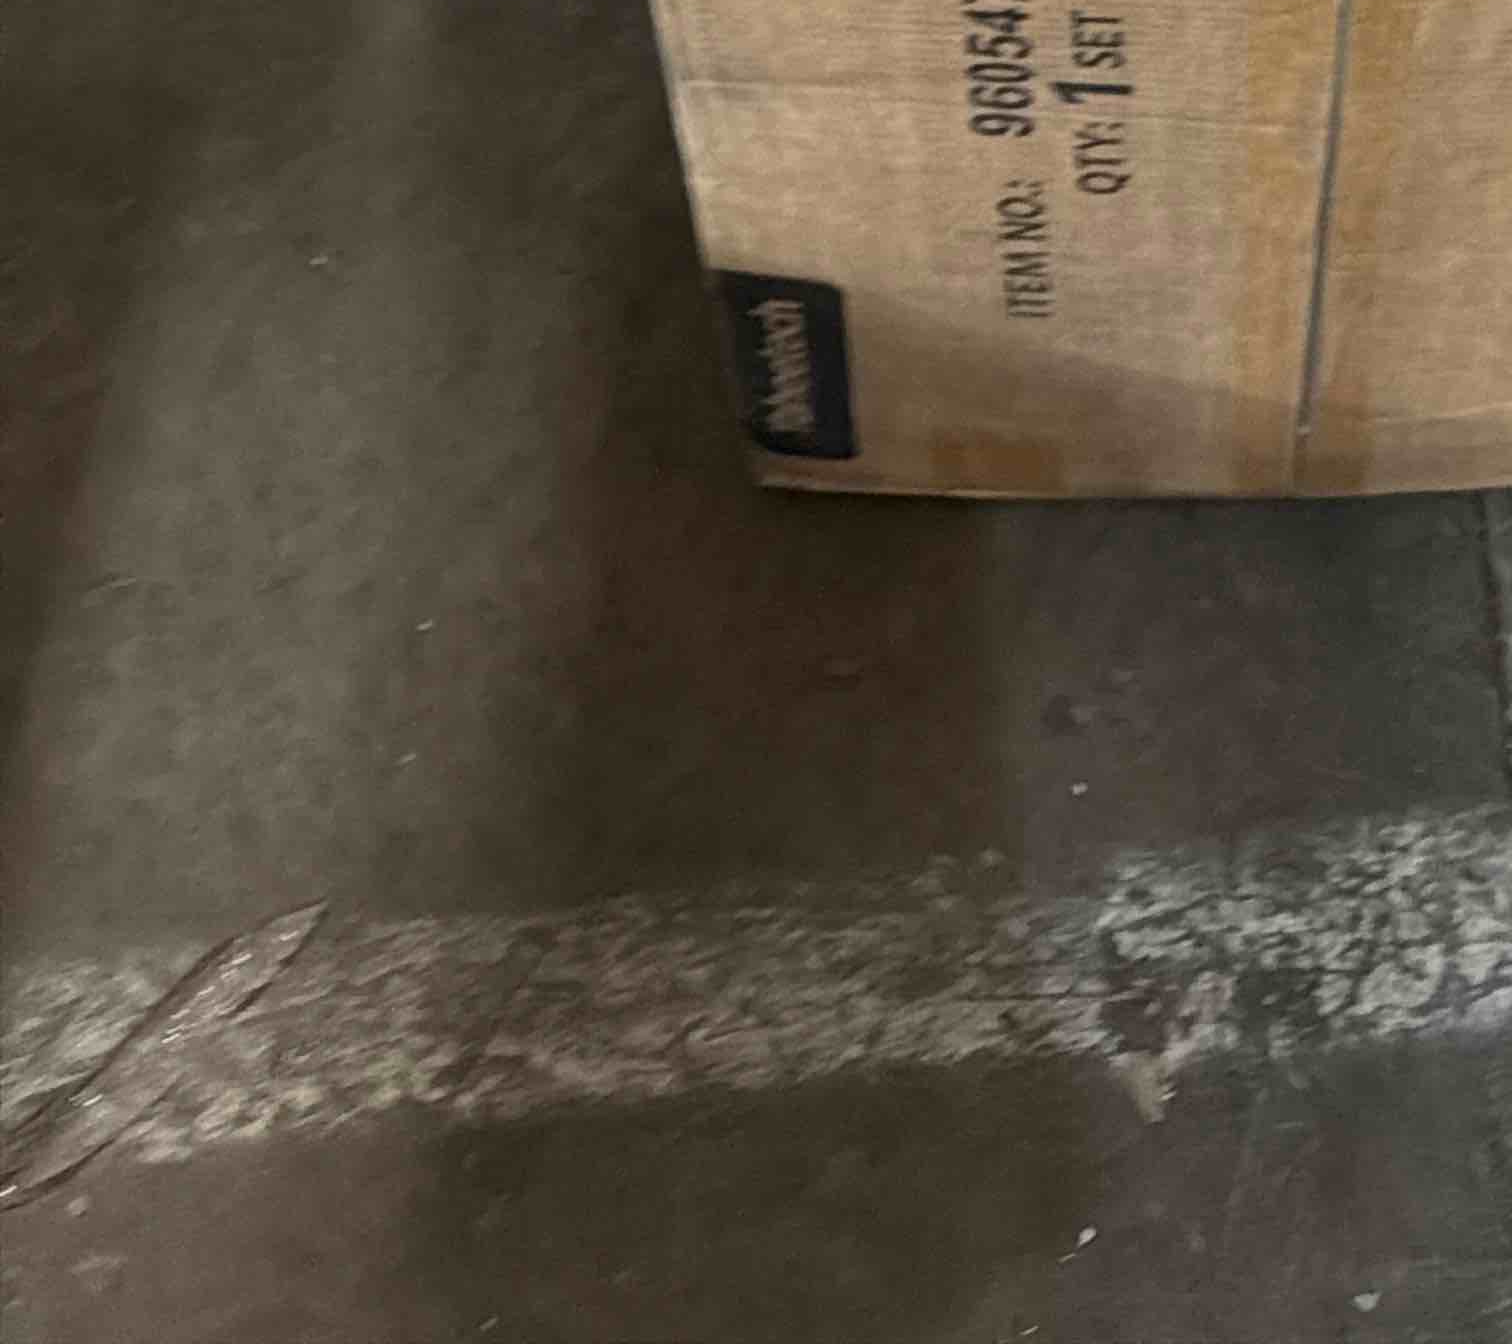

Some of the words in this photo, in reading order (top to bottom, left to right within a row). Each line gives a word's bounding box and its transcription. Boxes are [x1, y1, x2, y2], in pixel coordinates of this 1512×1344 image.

[1071, 9, 1127, 70] SET
[1048, 79, 1134, 106] 1
[1073, 120, 1133, 196] QTY:
[995, 178, 1048, 246] NO.:
[1003, 250, 1053, 318] ITEM
